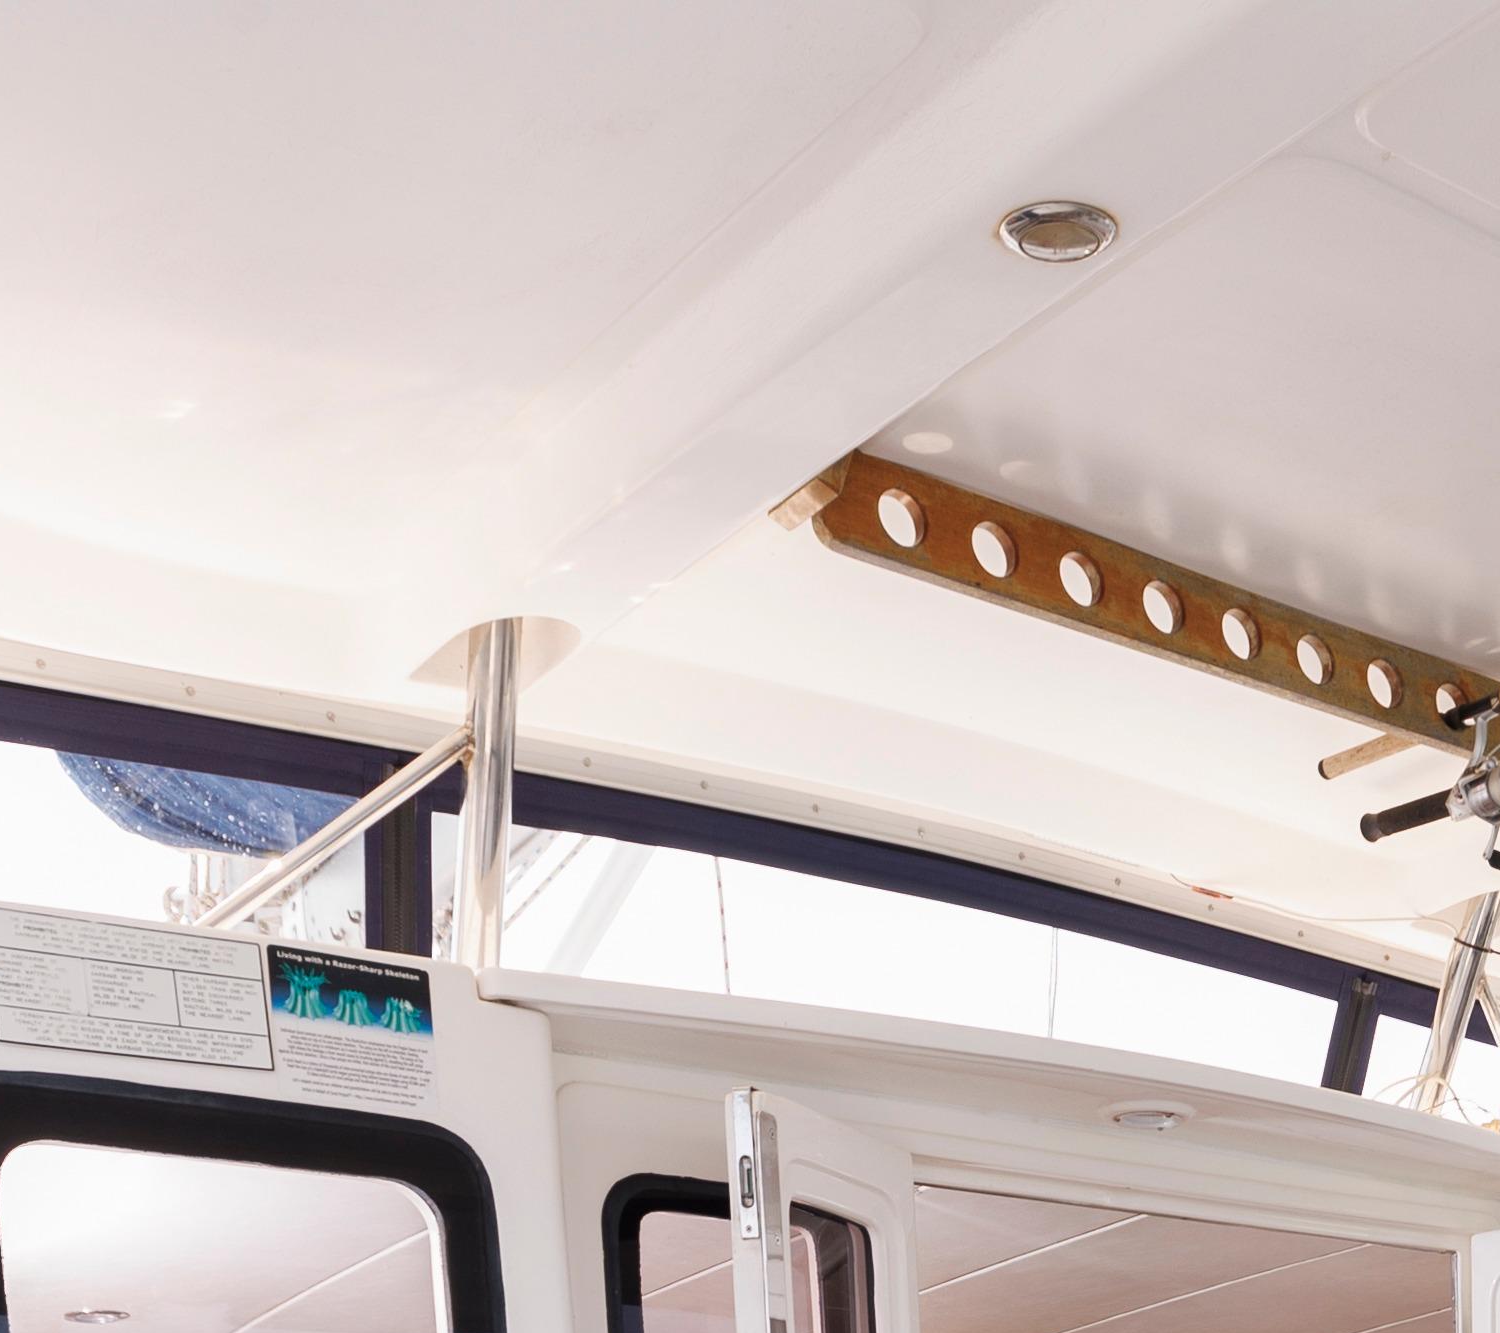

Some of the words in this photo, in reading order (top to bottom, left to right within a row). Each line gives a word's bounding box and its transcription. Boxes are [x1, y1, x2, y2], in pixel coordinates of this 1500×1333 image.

[277, 950, 302, 963] Living
[304, 954, 323, 965] with
[332, 960, 383, 975] Razor-Sharp
[385, 968, 420, 981] Skeleton
